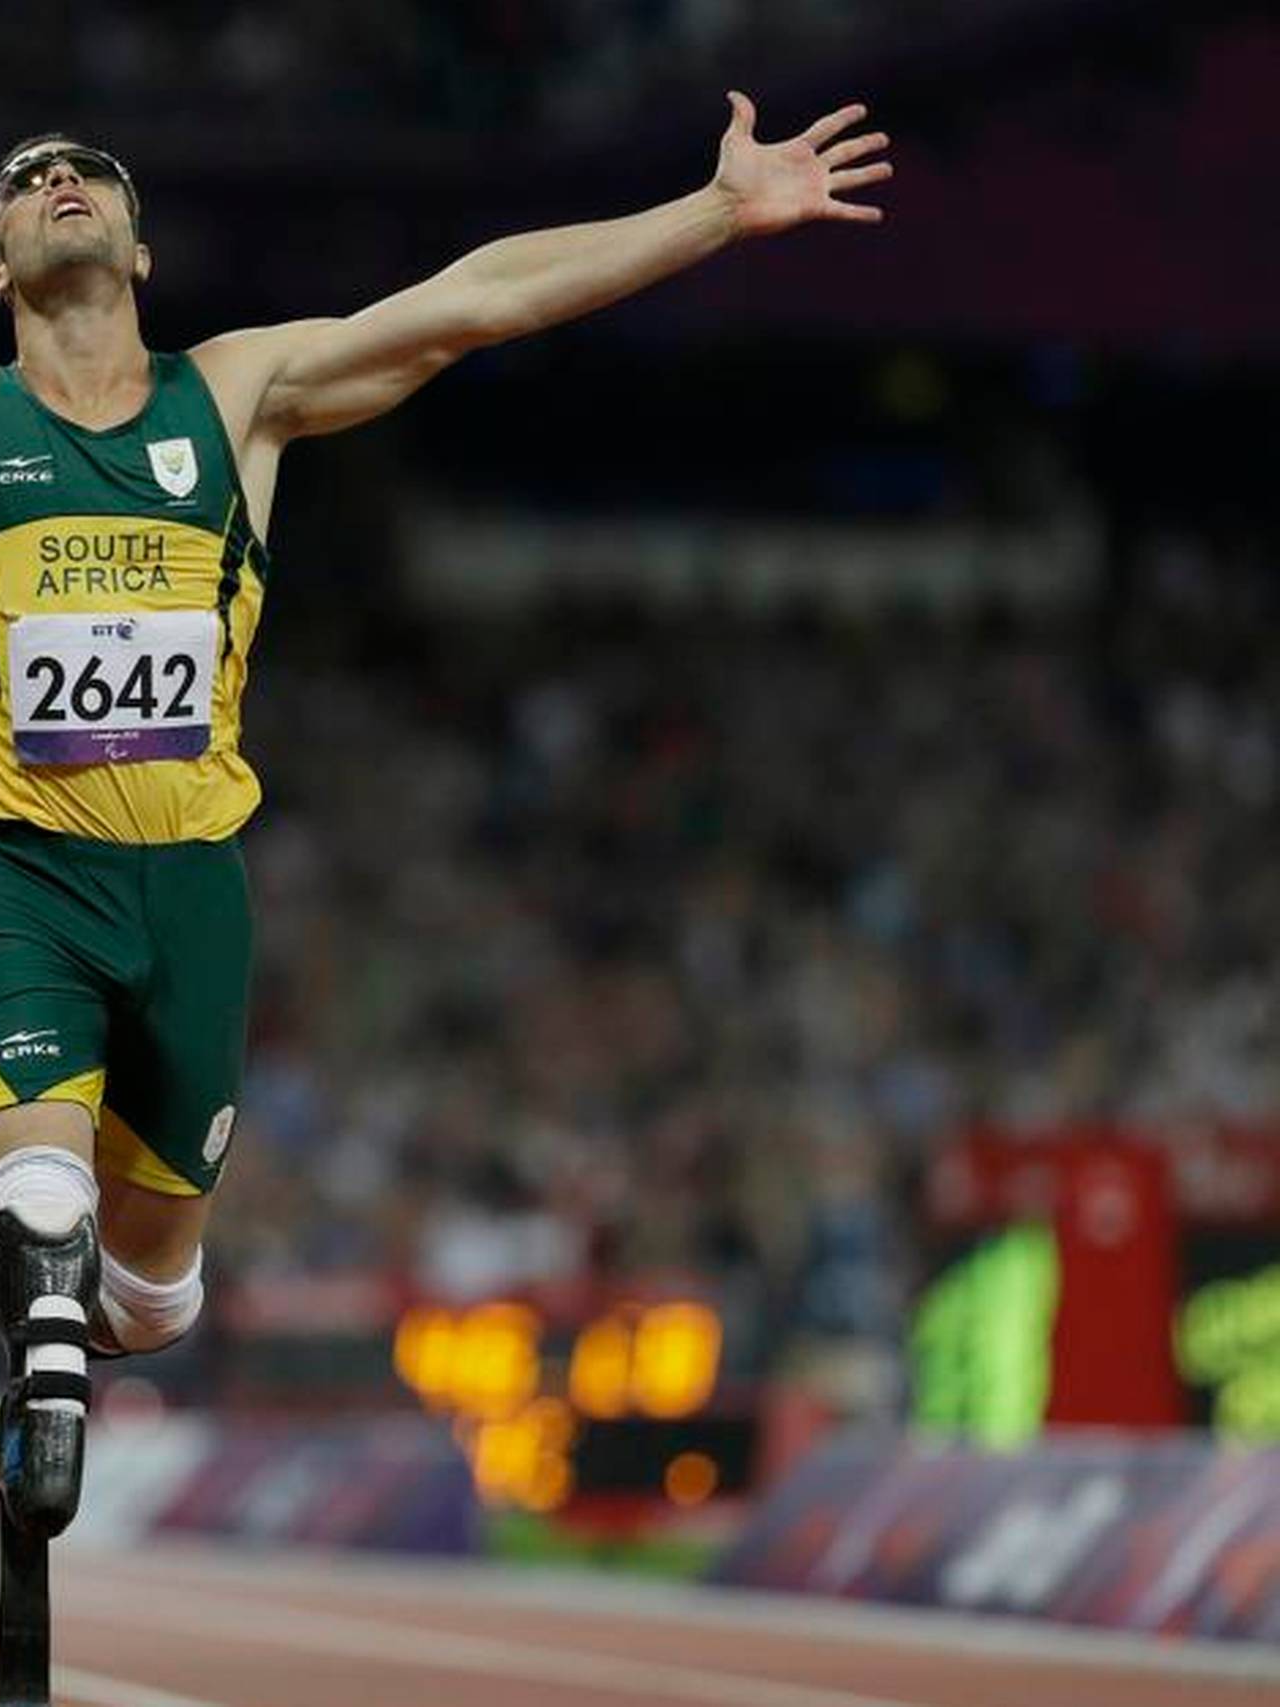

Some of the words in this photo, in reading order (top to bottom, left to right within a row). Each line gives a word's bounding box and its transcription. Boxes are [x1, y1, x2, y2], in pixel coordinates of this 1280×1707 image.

[39, 535, 165, 563] SOUTH
[36, 565, 171, 597] AFRICA
[25, 654, 197, 722] 2642
